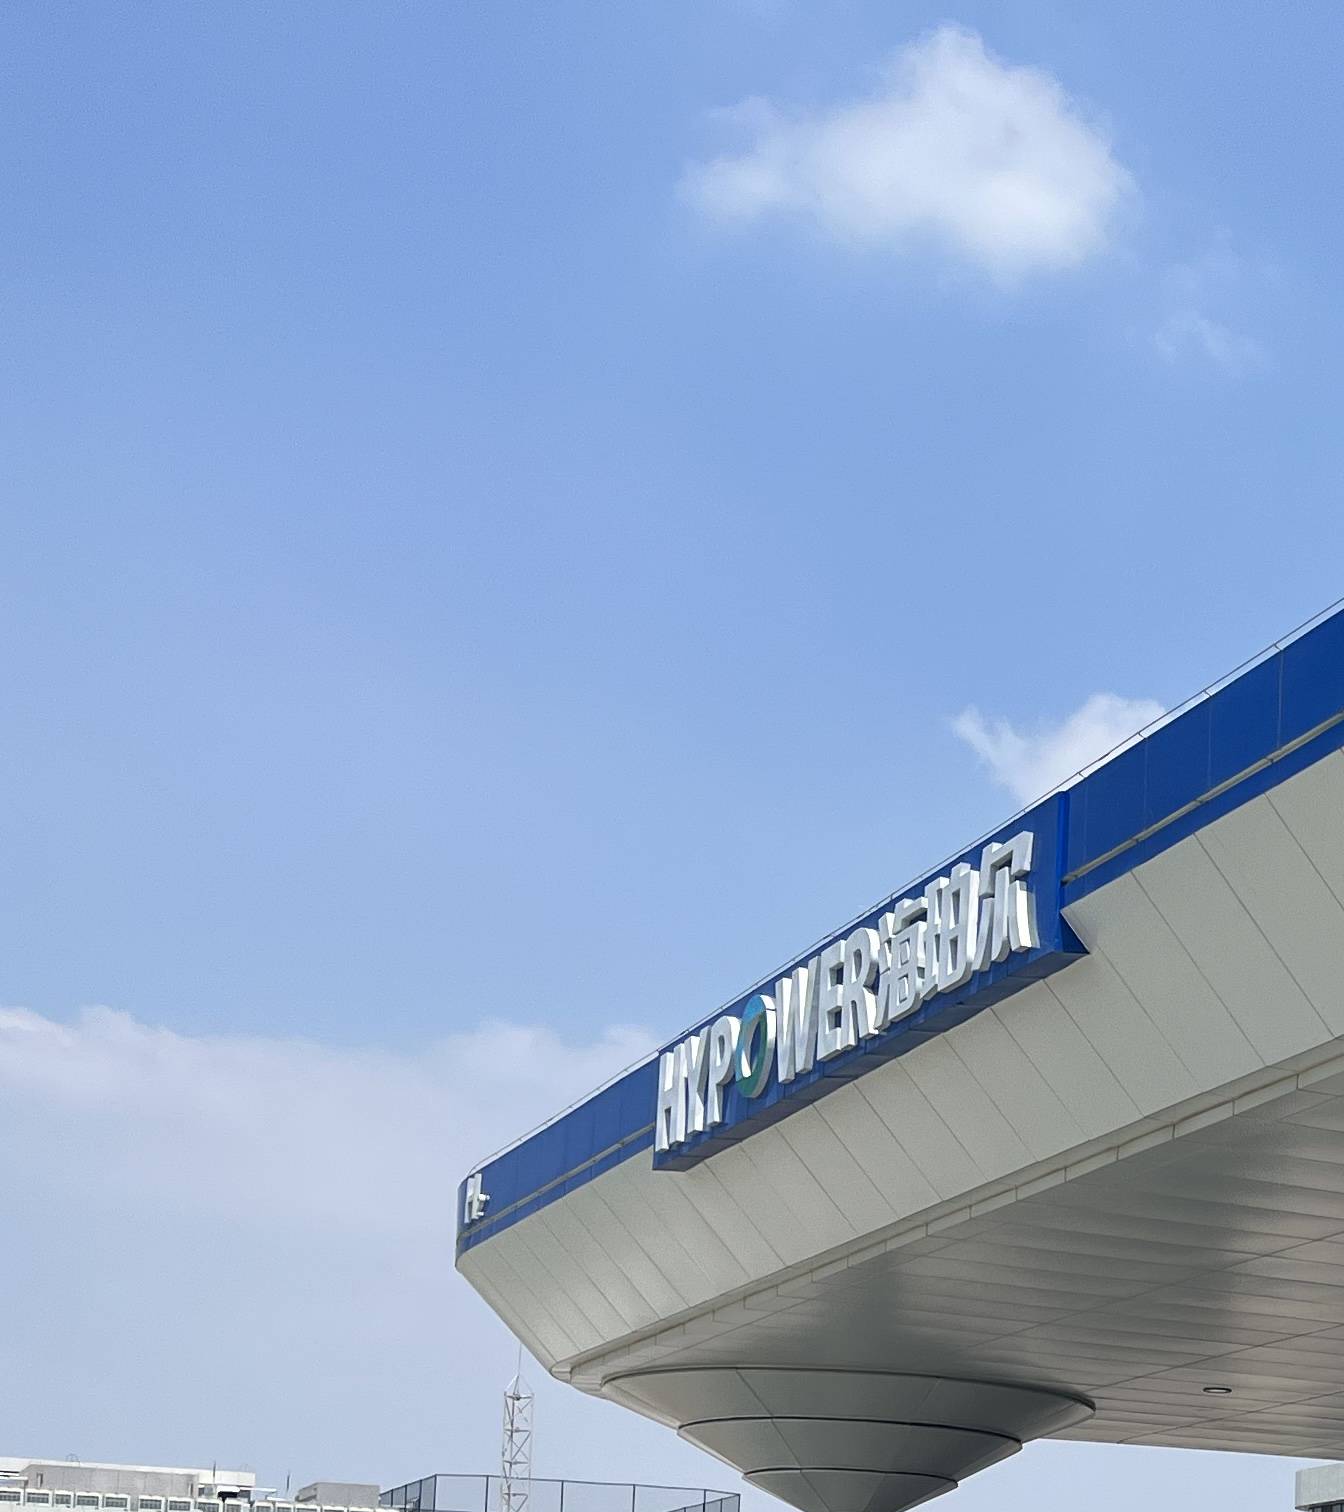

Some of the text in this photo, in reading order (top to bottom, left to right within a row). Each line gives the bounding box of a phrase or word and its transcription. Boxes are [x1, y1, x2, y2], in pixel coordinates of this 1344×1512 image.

[873, 830, 1040, 1031] 海珀尔
[655, 927, 880, 1154] HYPOWER
